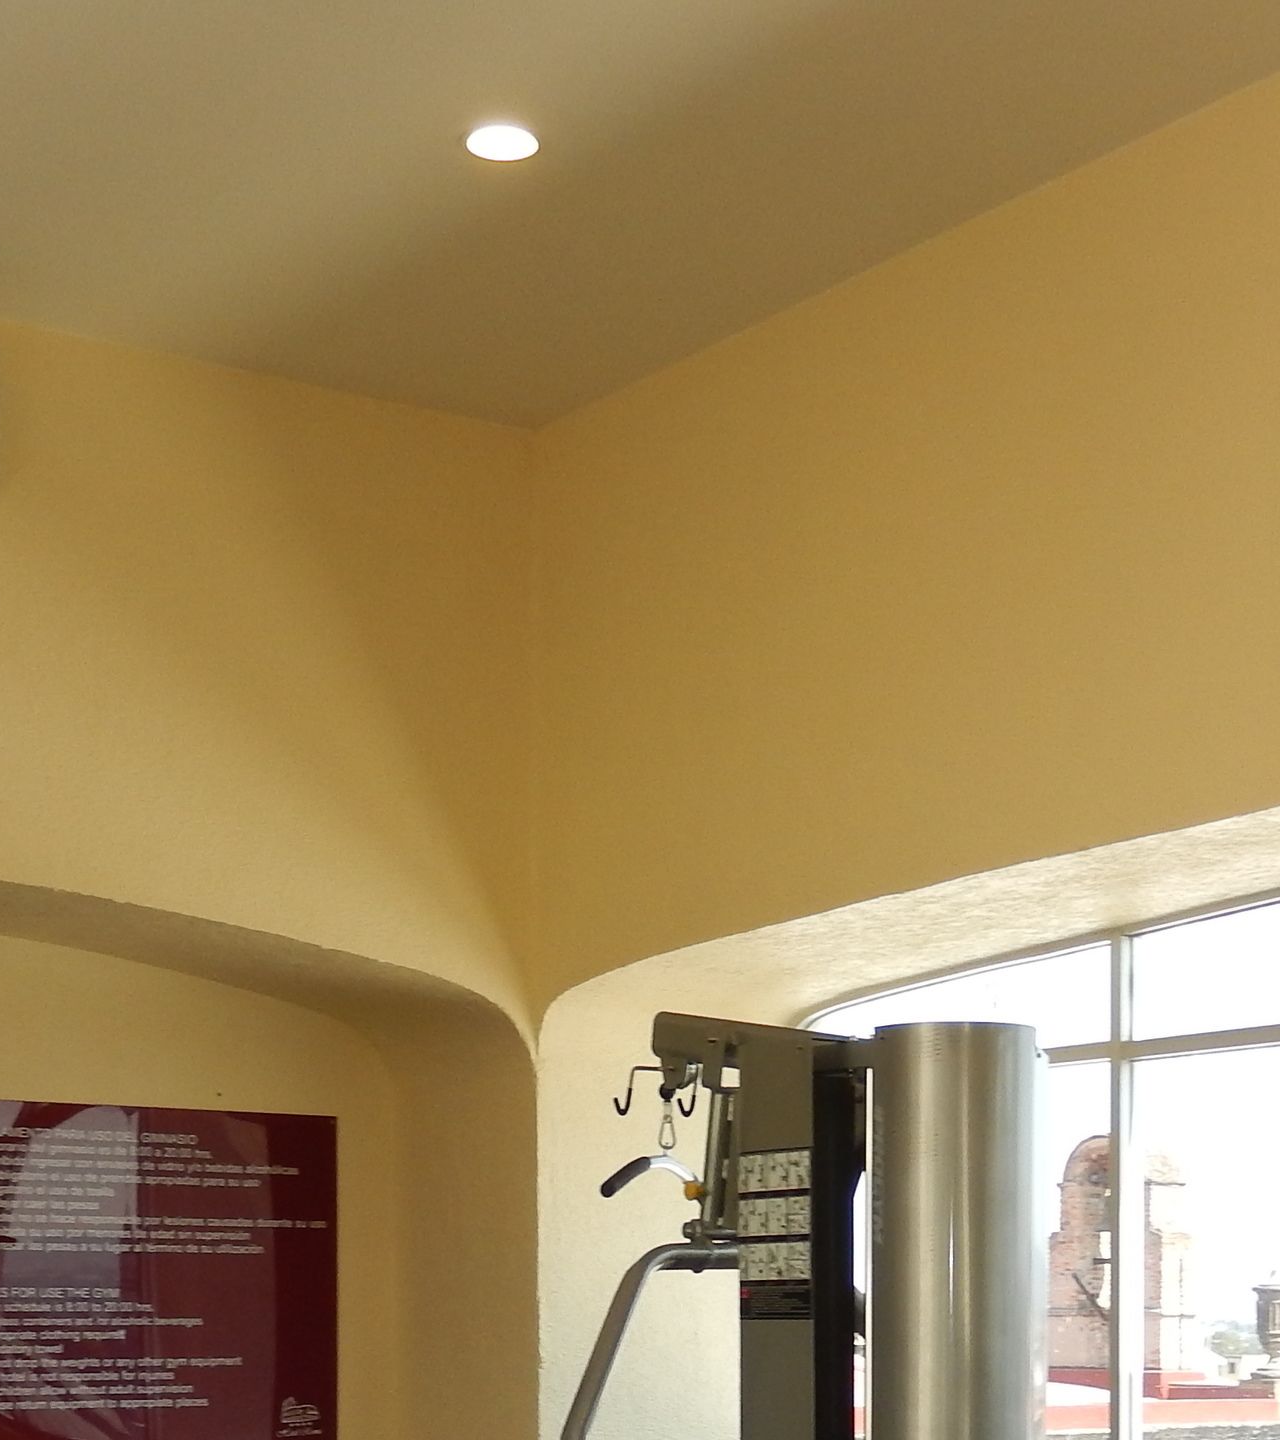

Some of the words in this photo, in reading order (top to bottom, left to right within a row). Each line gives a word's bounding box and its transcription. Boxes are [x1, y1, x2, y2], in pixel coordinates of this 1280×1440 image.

[140, 1132, 199, 1144] GIMNASIO
[10, 1286, 36, 1298] FOR
[38, 1286, 65, 1298] USE
[65, 1287, 91, 1298] THE
[91, 1288, 120, 1298] GYM
[164, 1358, 188, 1368] gym
